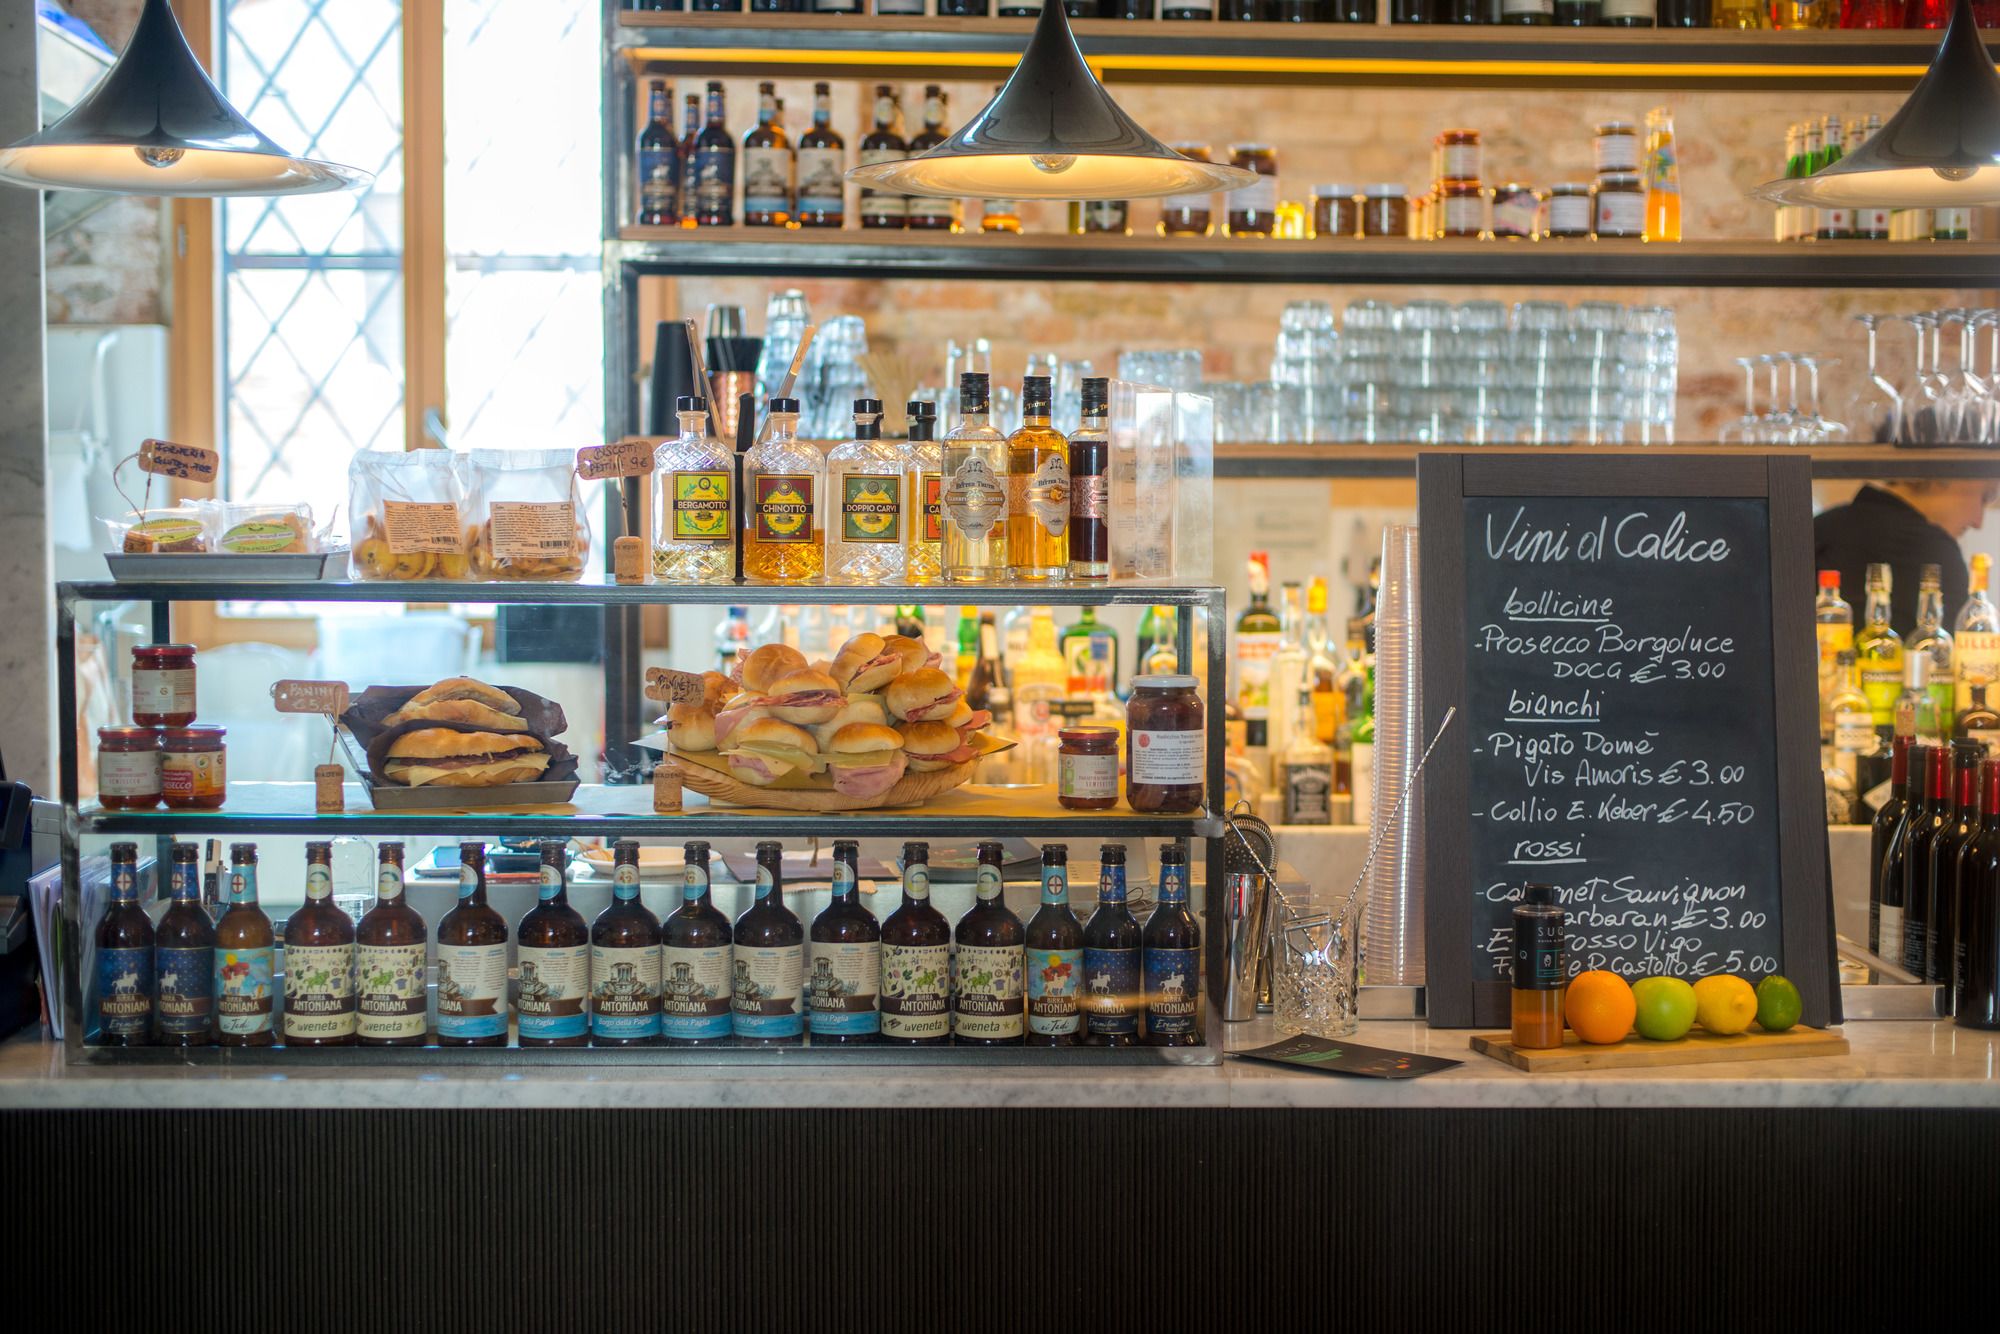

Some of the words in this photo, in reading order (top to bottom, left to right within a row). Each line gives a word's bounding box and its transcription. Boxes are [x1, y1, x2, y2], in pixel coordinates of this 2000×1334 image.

[678, 501, 727, 509] BERGAMOTTO
[762, 504, 806, 513] CHINOTTO
[847, 504, 875, 512] DOPPIO
[1487, 506, 1570, 562] Vini
[1615, 511, 1731, 562] Calice
[1503, 587, 1613, 617] bollicine
[1595, 624, 1734, 662] Borgoluce
[1673, 660, 1725, 680] 3.00
[1509, 689, 1605, 717] bianchi
[1488, 732, 1574, 763] Pigato
[1524, 760, 1565, 788] Vis
[1576, 758, 1653, 788] Amoris
[1491, 796, 1557, 823] Collio
[1599, 793, 1657, 823] Keber
[1692, 799, 1754, 825] 4.50
[1514, 833, 1585, 859] rossi
[1602, 876, 1746, 912] Sauvignon
[1563, 904, 1667, 928] arbaran
[1645, 931, 1701, 963] Vigo
[102, 1001, 150, 1014] ANTONIANA
[293, 1000, 342, 1011] ANTONIANA
[361, 1000, 408, 1011] ANTONIANA
[600, 1001, 648, 1012] ANTONIANA
[900, 1000, 946, 1012] ANTONIANA
[960, 1000, 1005, 1012] ANTONIANA
[1033, 1003, 1076, 1012] ANTONIANA
[1150, 1003, 1194, 1014] ANTONIANA
